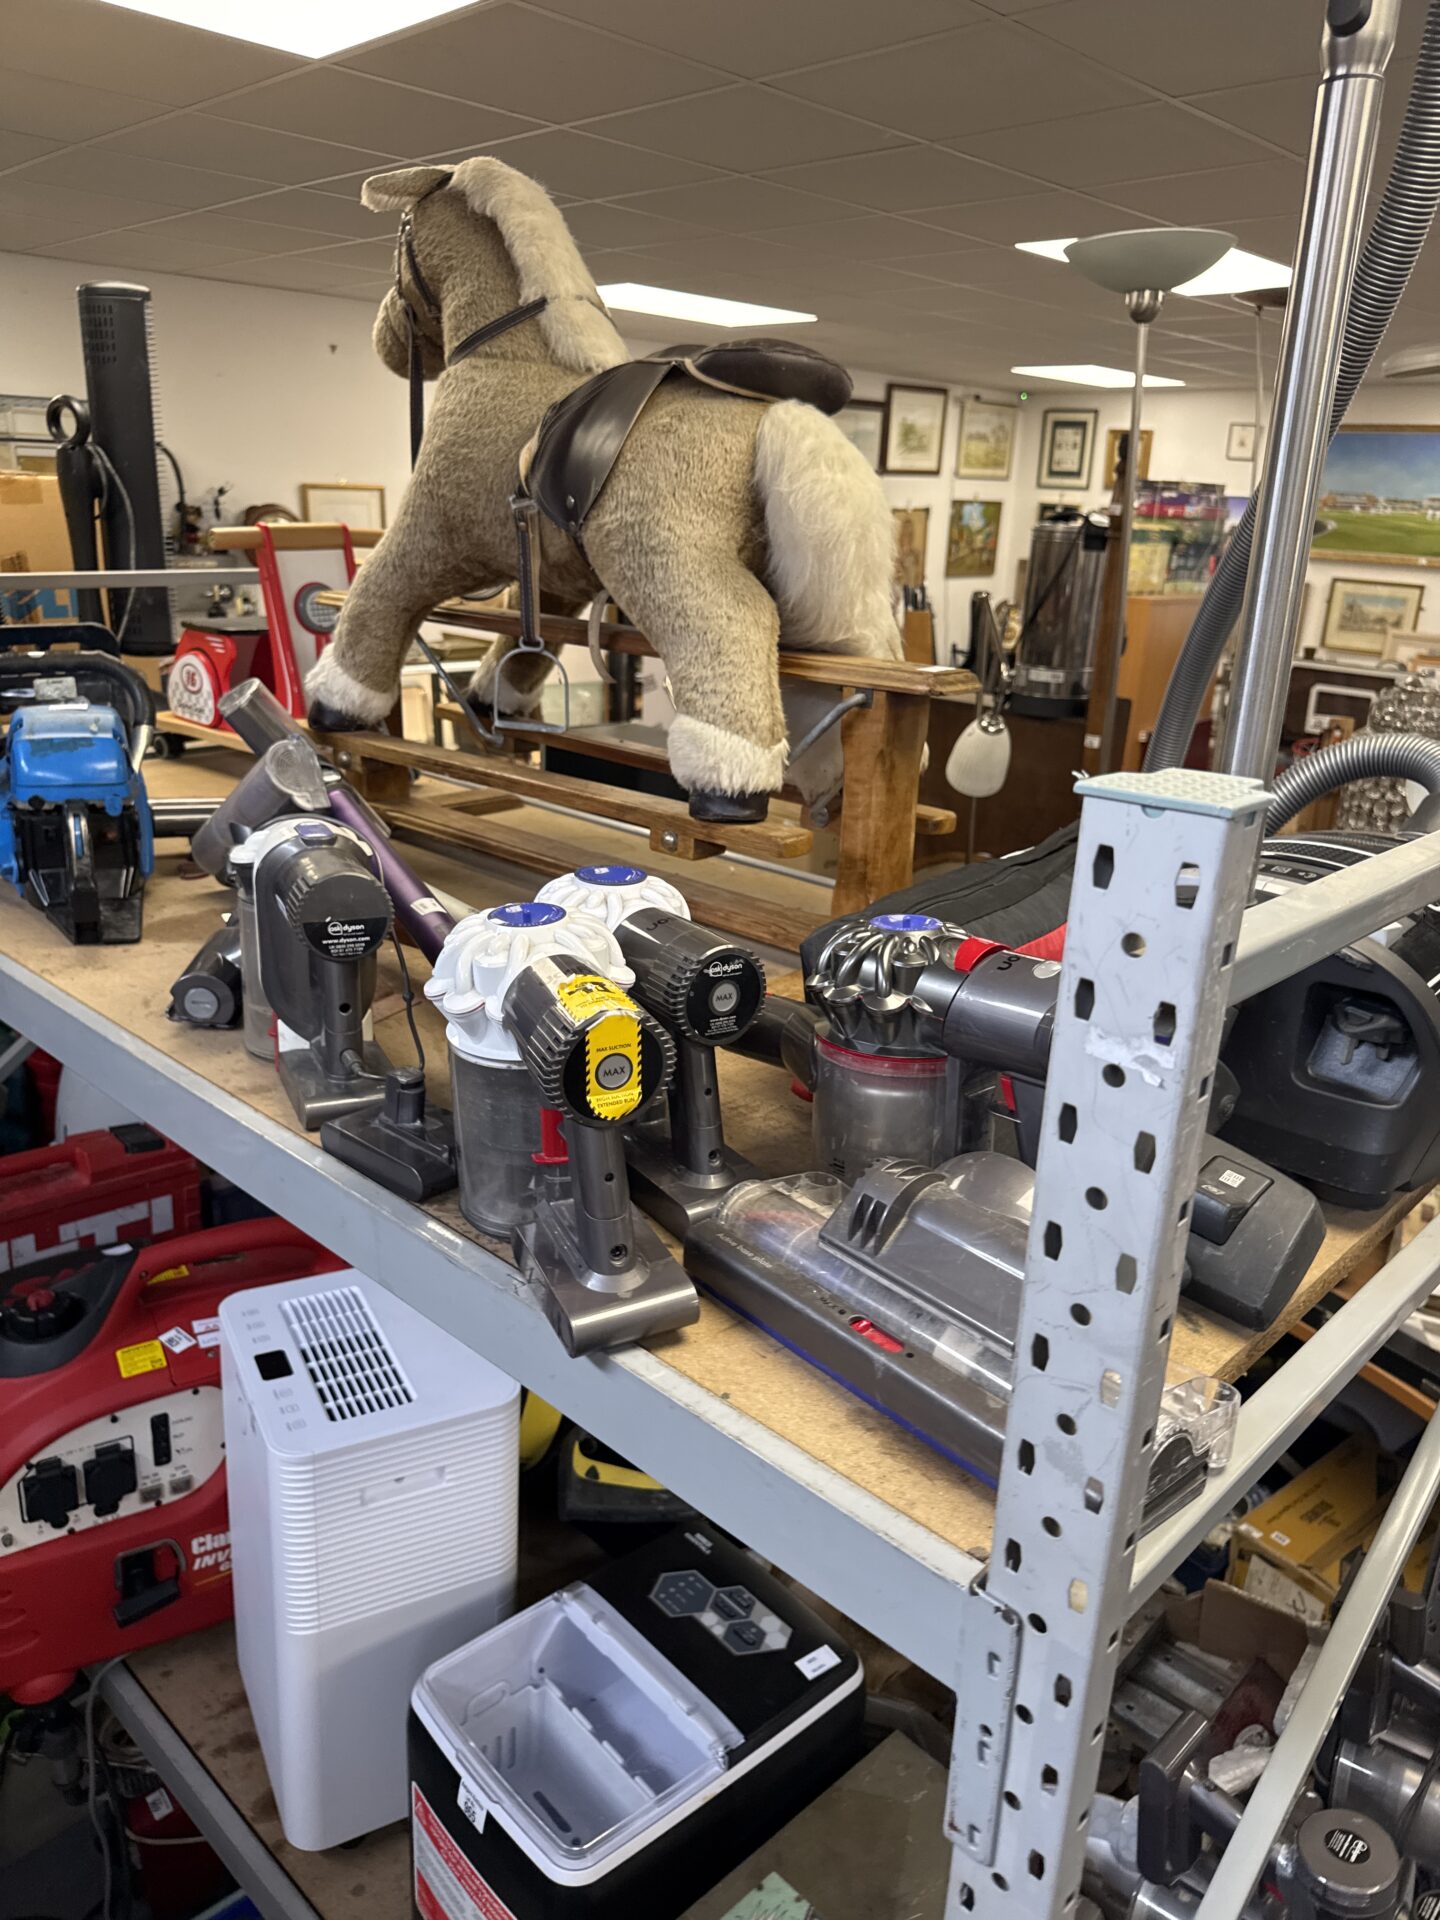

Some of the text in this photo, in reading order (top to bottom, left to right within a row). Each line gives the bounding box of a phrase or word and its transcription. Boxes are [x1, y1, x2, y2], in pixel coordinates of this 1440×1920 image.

[342, 924, 364, 932] dyson
[722, 963, 743, 972] dyson
[716, 993, 733, 1002] MAX
[608, 1043, 632, 1051] SUCTION
[603, 1066, 626, 1077] MAX
[597, 1097, 636, 1109] EXTENDED RUN
[737, 1244, 754, 1257] base
[752, 1256, 773, 1268] plate
